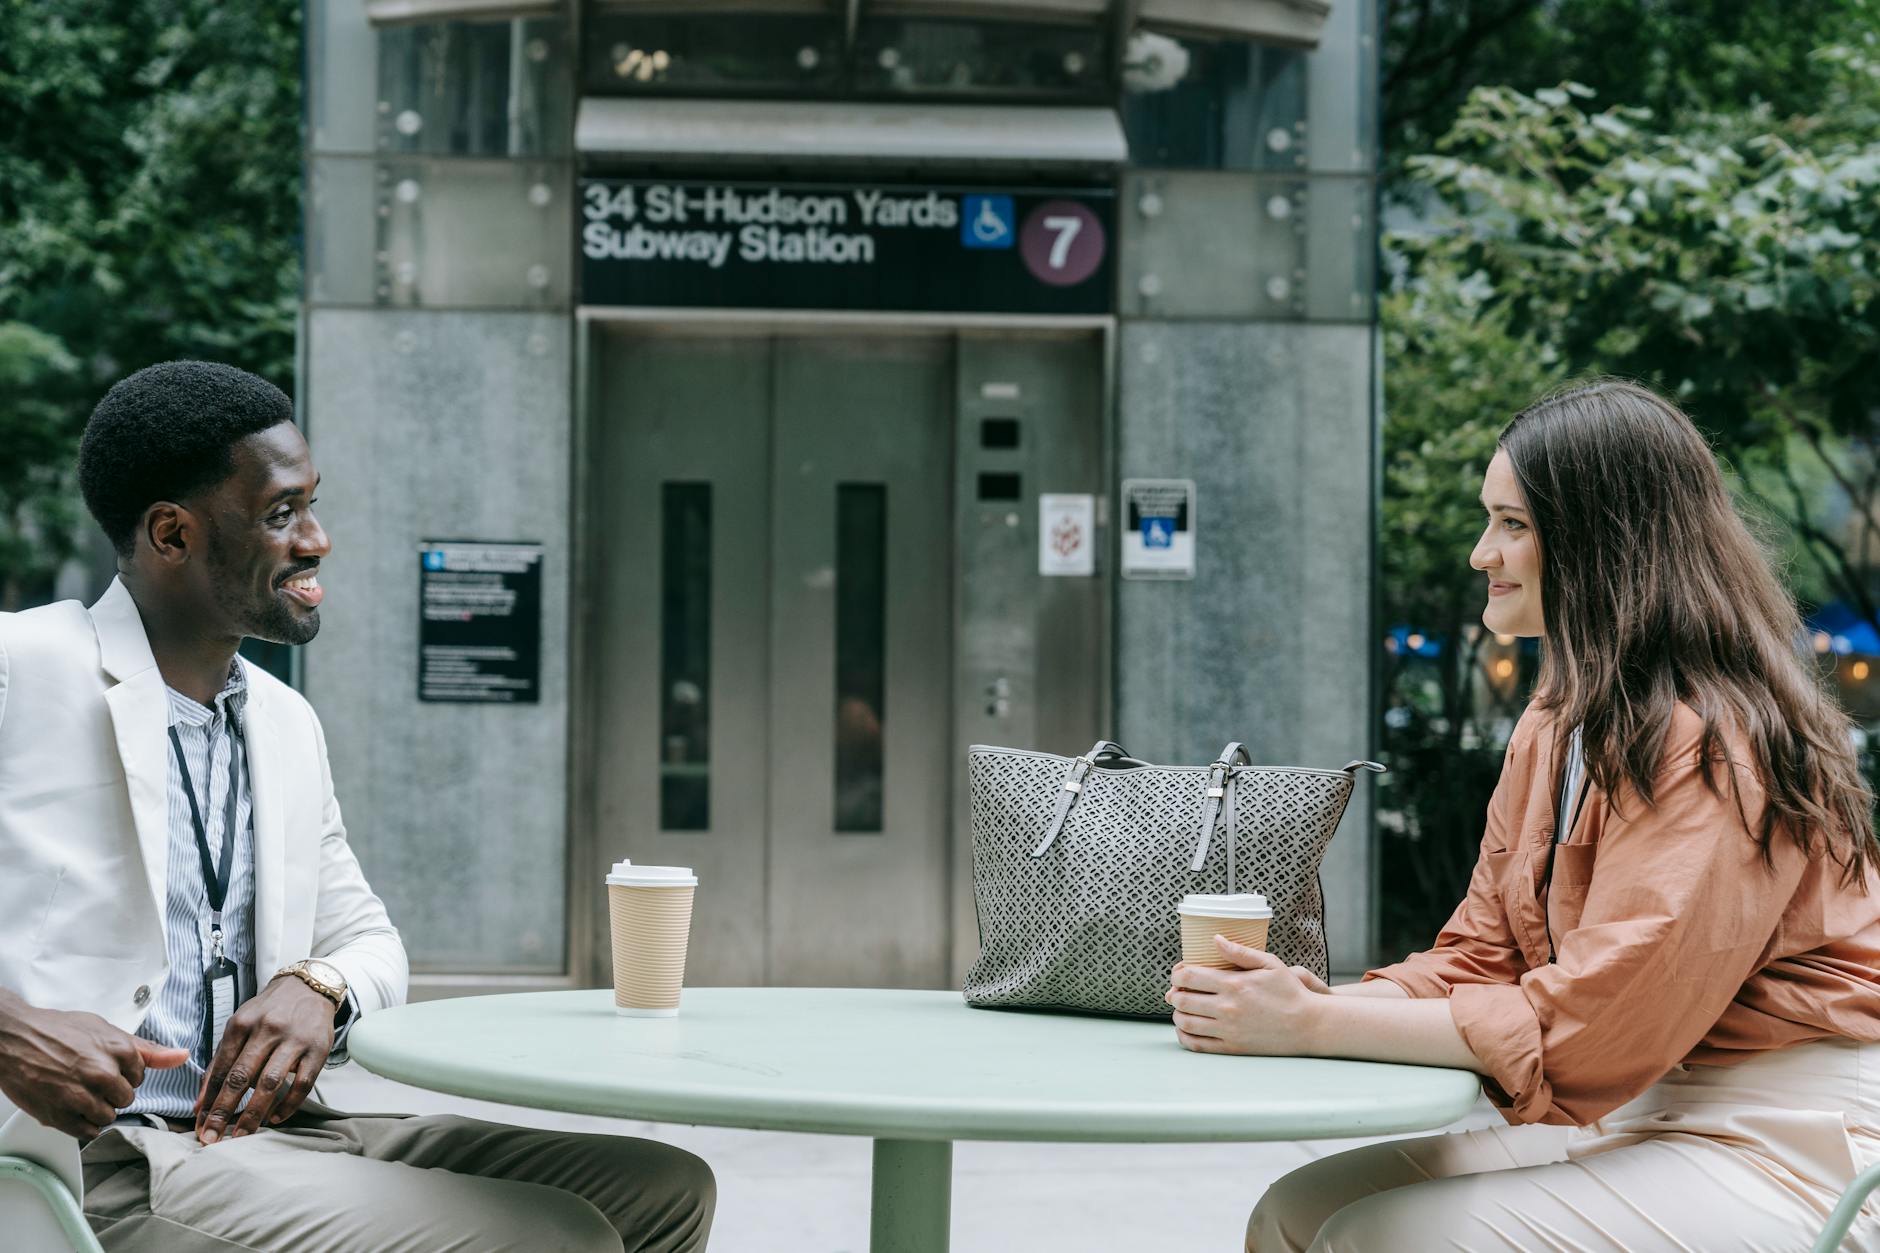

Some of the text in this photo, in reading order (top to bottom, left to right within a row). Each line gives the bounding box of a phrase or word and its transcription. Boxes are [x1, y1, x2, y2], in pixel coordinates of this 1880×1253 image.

[583, 183, 958, 227] 34 St-Hudson Yards
[583, 221, 875, 268] Subway Station
[1043, 215, 1082, 269] 7
